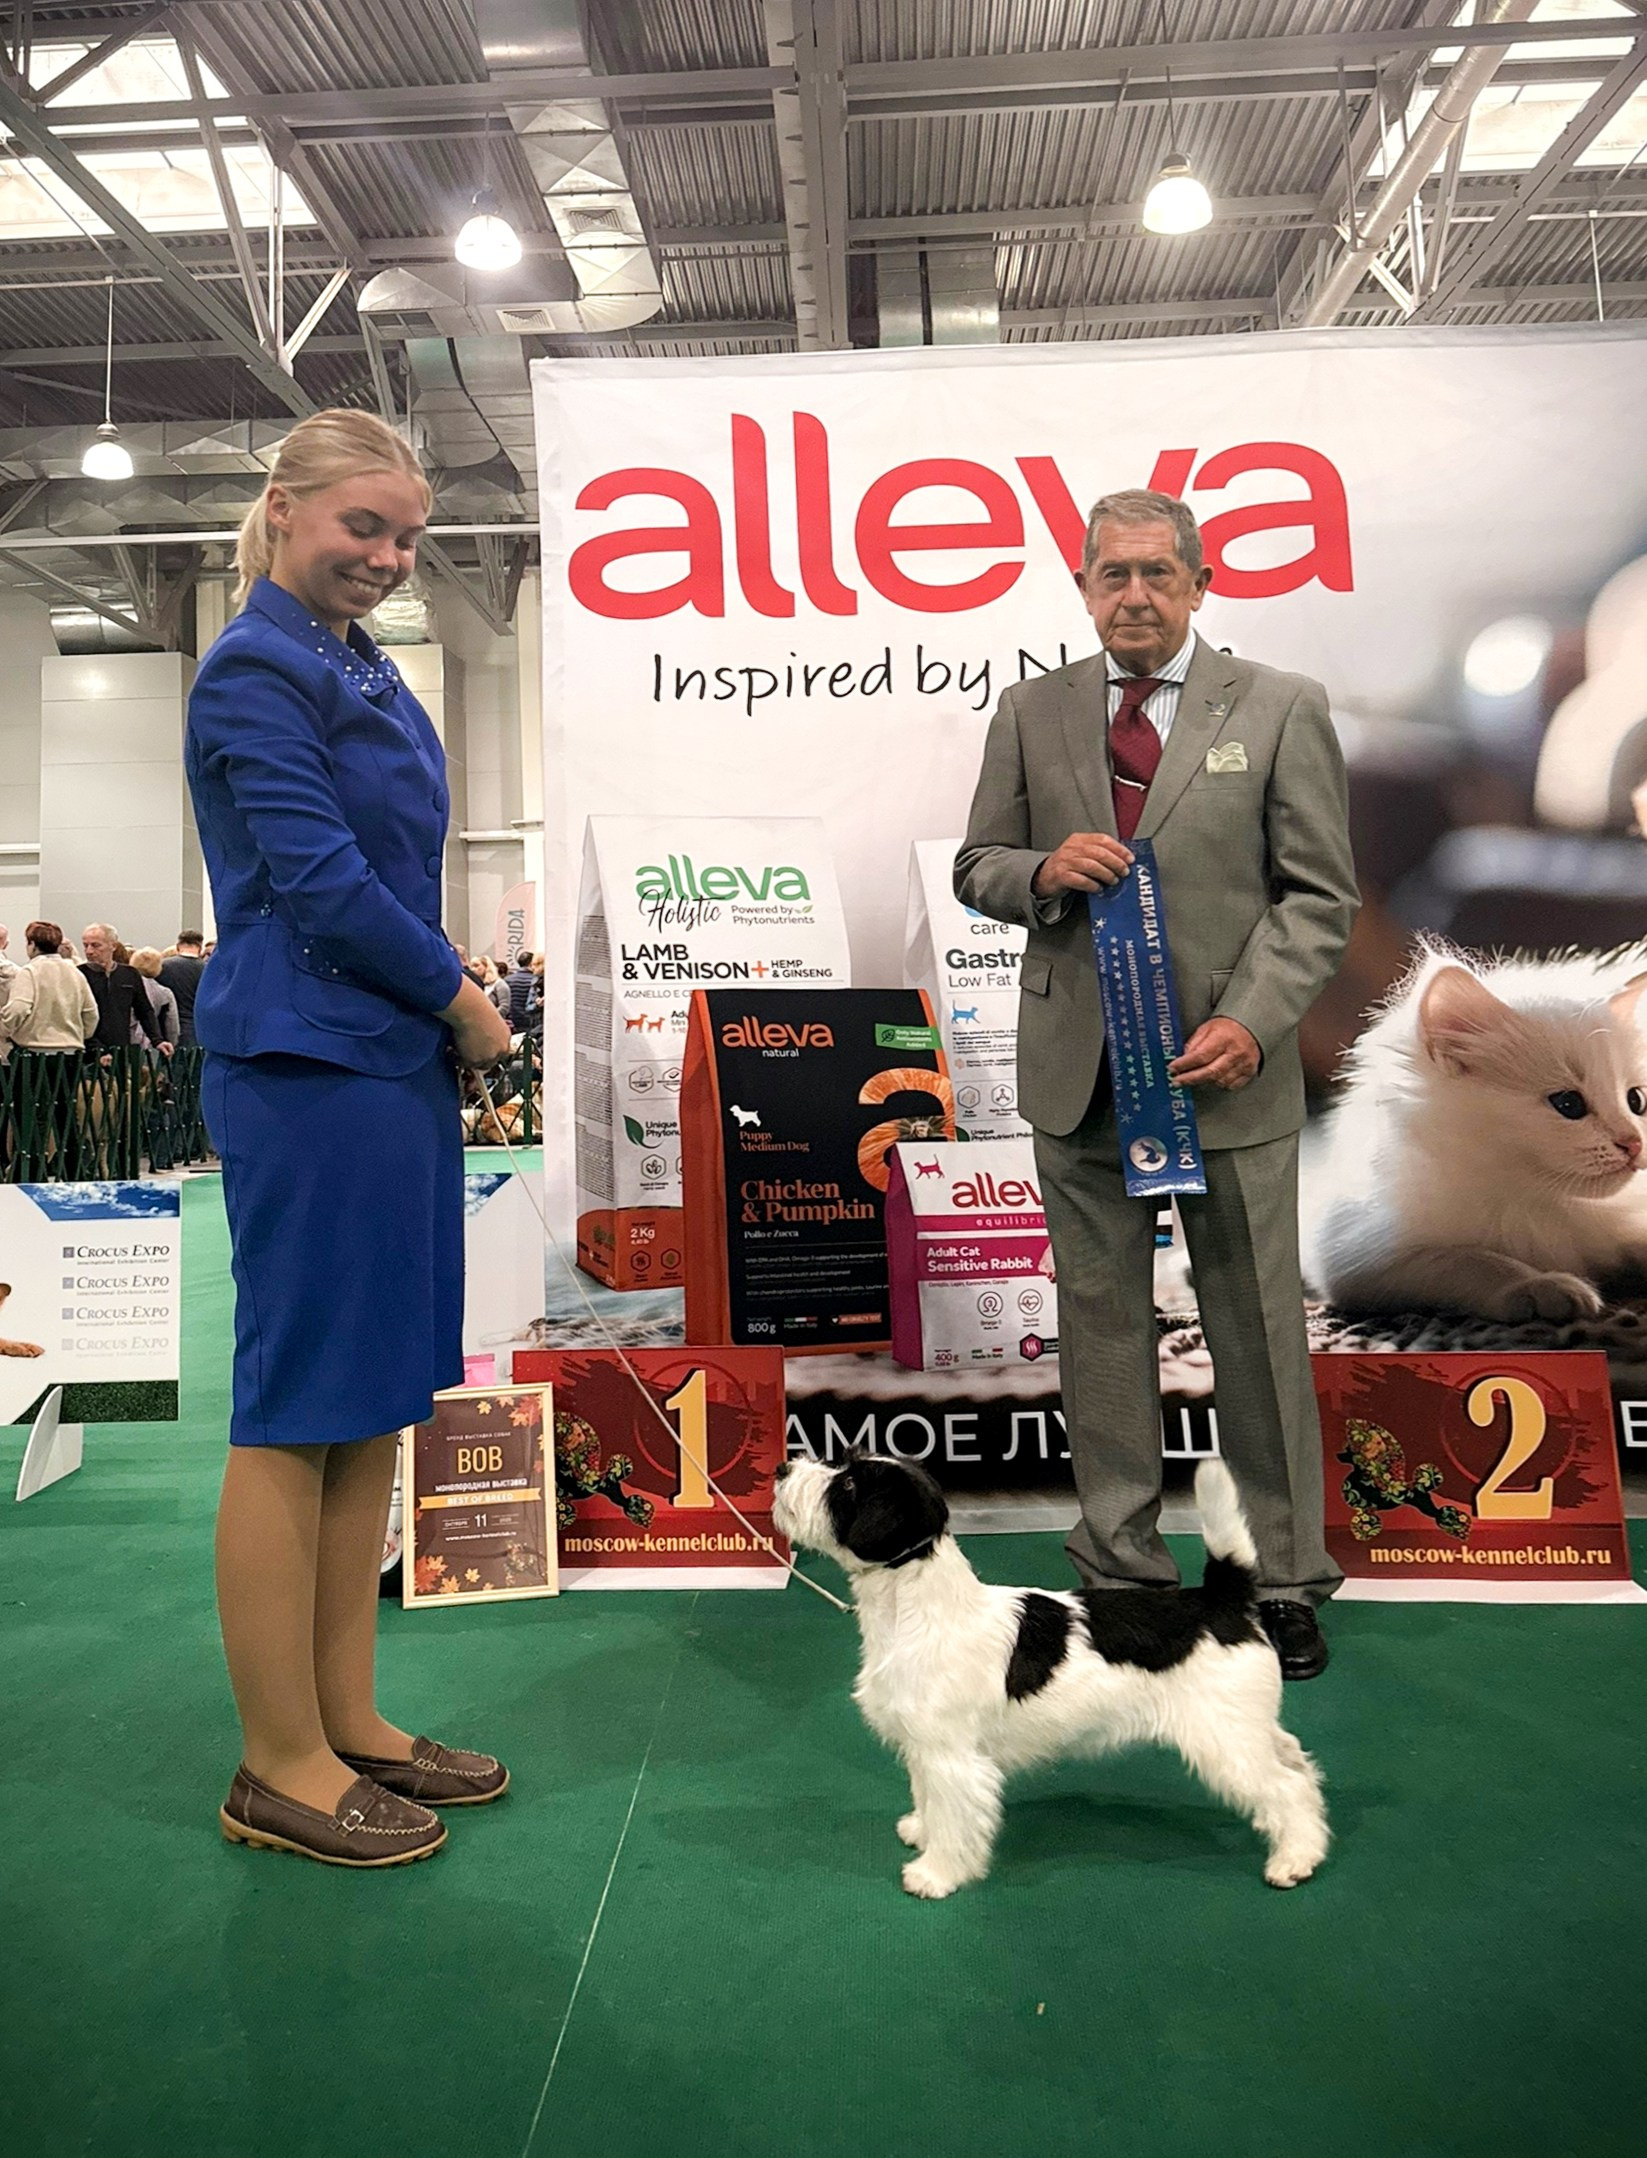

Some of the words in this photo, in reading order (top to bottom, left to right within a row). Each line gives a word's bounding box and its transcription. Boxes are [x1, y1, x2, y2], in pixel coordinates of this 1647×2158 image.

[568, 410, 1354, 620] alleva
[651, 646, 893, 717] Inspired
[915, 643, 993, 711] by
[635, 854, 811, 901] alleva
[638, 887, 726, 934] Holistic
[731, 905, 778, 914] Powered
[780, 905, 793, 915] by
[1137, 864, 1162, 950] КАНДИДАТ
[733, 915, 815, 926] Phytonutrients
[970, 923, 1010, 935] care
[621, 944, 690, 961] LAMB
[945, 948, 1020, 970] Gastr
[1150, 954, 1163, 965] В
[622, 963, 639, 980] &
[644, 962, 750, 980] VENISON
[771, 960, 803, 969] HEMP
[782, 968, 833, 978] GINSENG
[948, 974, 982, 988] Low
[987, 973, 1012, 986] Fat
[624, 989, 671, 999] AGNELLO
[674, 989, 680, 998] E
[1153, 968, 1176, 1061] ЧЕМПИОНЫ
[721, 1015, 834, 1048] alleva
[762, 1049, 799, 1058] natural
[645, 1121, 677, 1130] Unique
[739, 1131, 772, 1142] Puppy
[741, 1142, 787, 1152] Medium
[787, 1141, 810, 1153] Dog
[1173, 1126, 1198, 1170] (КЧК)
[740, 1179, 840, 1201] Chicken
[952, 1172, 1045, 1209] allev
[741, 1202, 760, 1223] &
[765, 1198, 875, 1226] Pumpkin
[630, 1228, 638, 1238] 2
[640, 1227, 656, 1239] Kg
[744, 1231, 766, 1239] Pollo
[774, 1230, 799, 1238] Zucca
[77, 1245, 129, 1258] CROCUS
[132, 1244, 170, 1257] EXPO
[926, 1246, 958, 1258] Adult
[960, 1246, 981, 1257] Cat
[927, 1258, 988, 1273] Sensitive
[990, 1257, 1034, 1270] Rabbit
[77, 1276, 128, 1289] CROCUS
[132, 1275, 170, 1288] EXPO
[76, 1307, 128, 1320] CROCUS
[131, 1305, 169, 1318] EXPO
[747, 1323, 769, 1334] 800
[770, 1323, 777, 1334] g
[934, 1353, 953, 1362] 400
[665, 1369, 715, 1508] 1
[785, 1412, 982, 1463] АМОЕ
[1466, 1376, 1554, 1520] 2
[457, 1445, 503, 1474] BOB
[447, 1497, 469, 1505] BEST
[485, 1493, 514, 1502] BREED
[474, 1513, 487, 1527] 11
[564, 1533, 774, 1553] moscow-kennelclub.ru
[1370, 1545, 1612, 1568] moscow-kennelclub.ru
